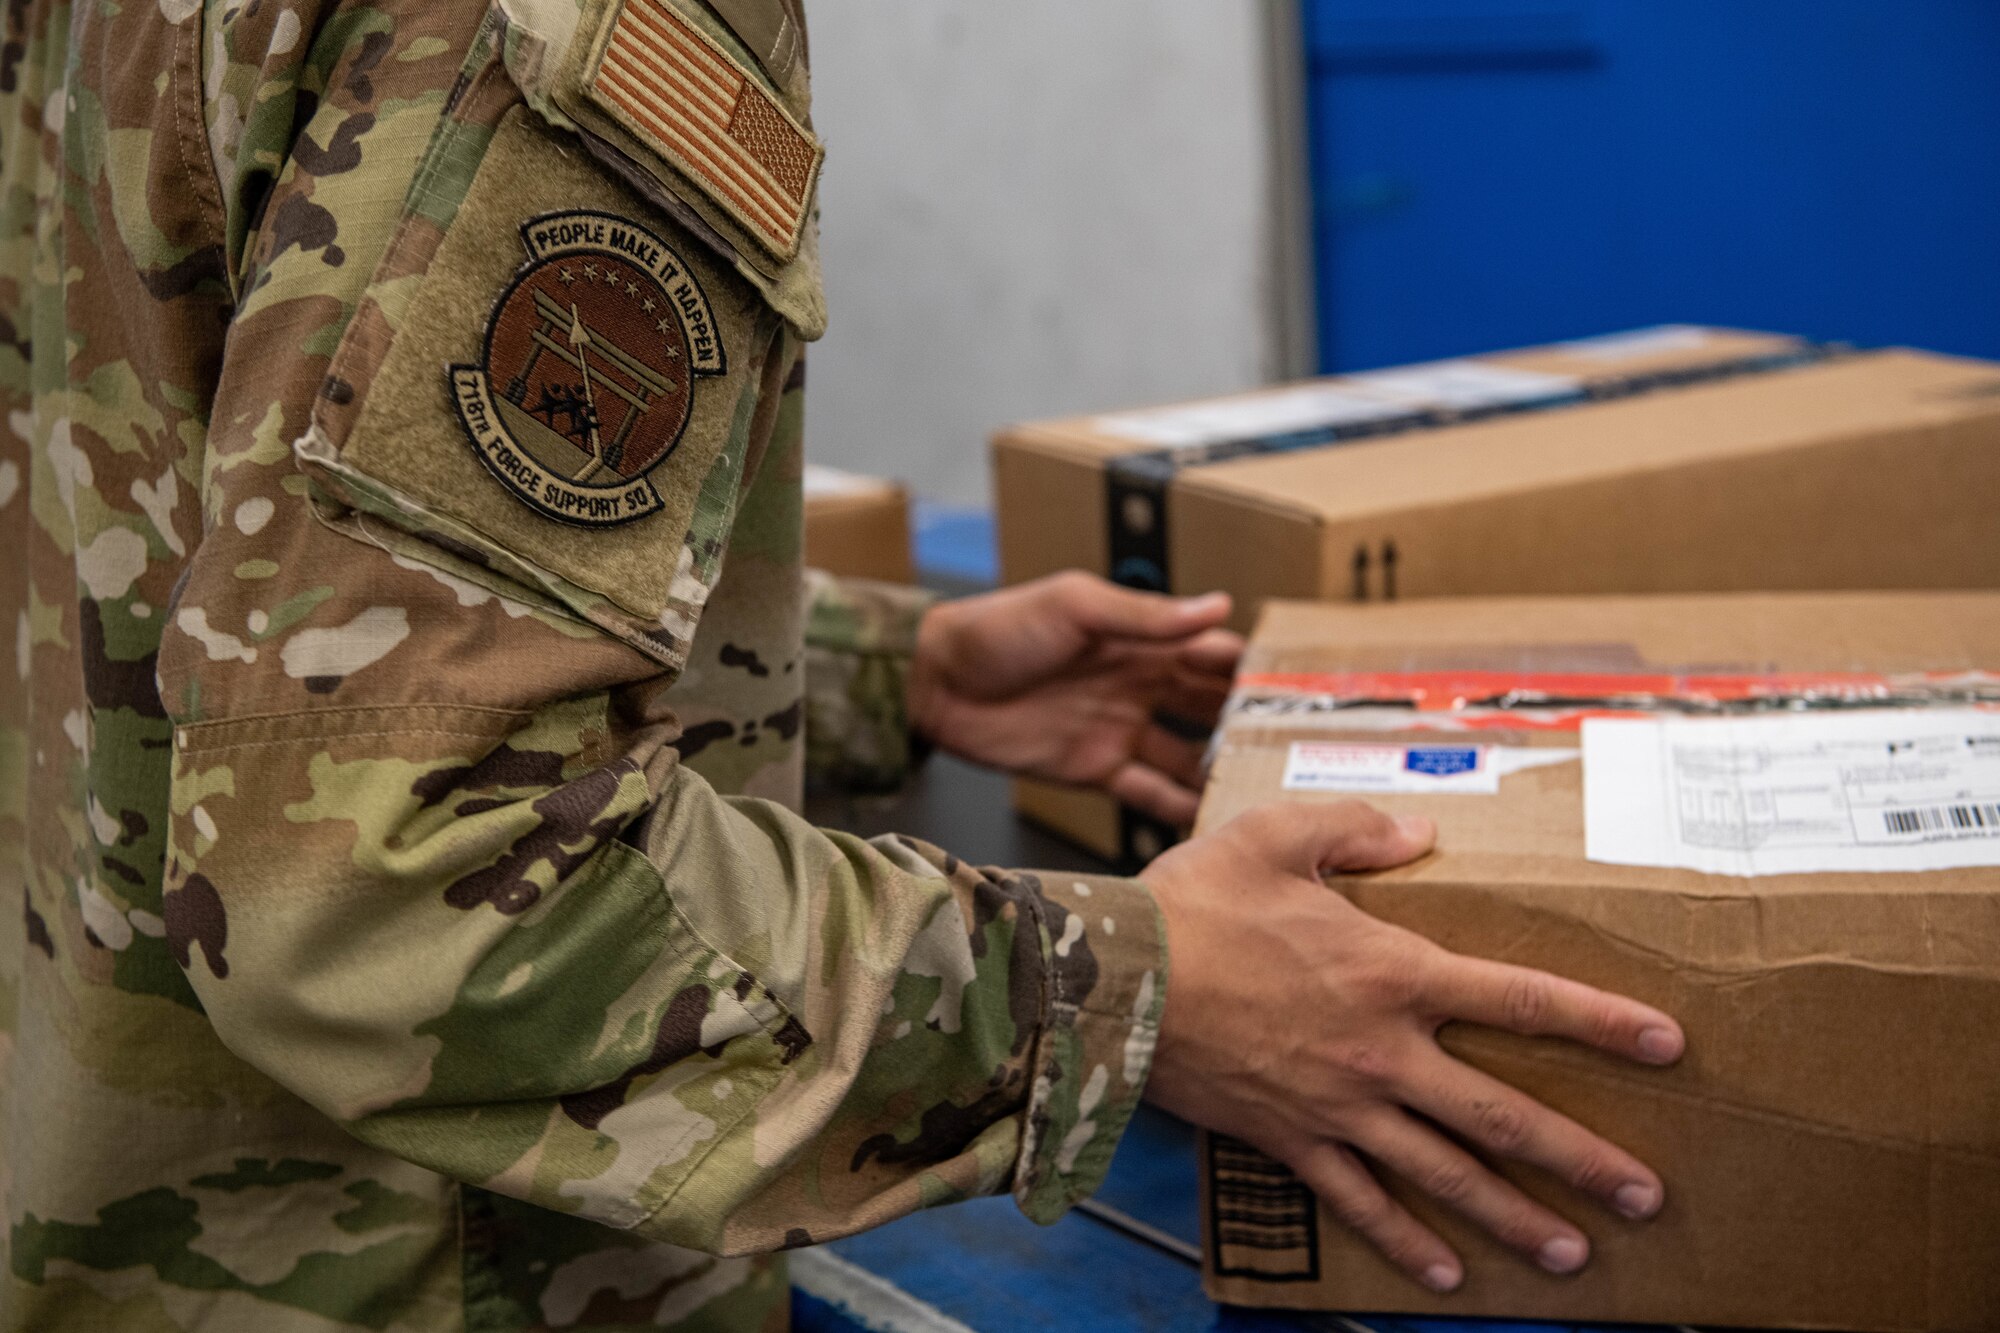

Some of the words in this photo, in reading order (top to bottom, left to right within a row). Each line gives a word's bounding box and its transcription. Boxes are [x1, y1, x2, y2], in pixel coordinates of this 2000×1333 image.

[535, 223, 604, 251] PEOPLE
[609, 227, 660, 269] MAKE
[659, 262, 679, 282] IT
[674, 284, 714, 361] HAPPEN
[460, 375, 491, 434] 718TH
[487, 436, 542, 492] FORCE
[543, 483, 621, 517] SUPPORT
[624, 486, 648, 511] SQ
